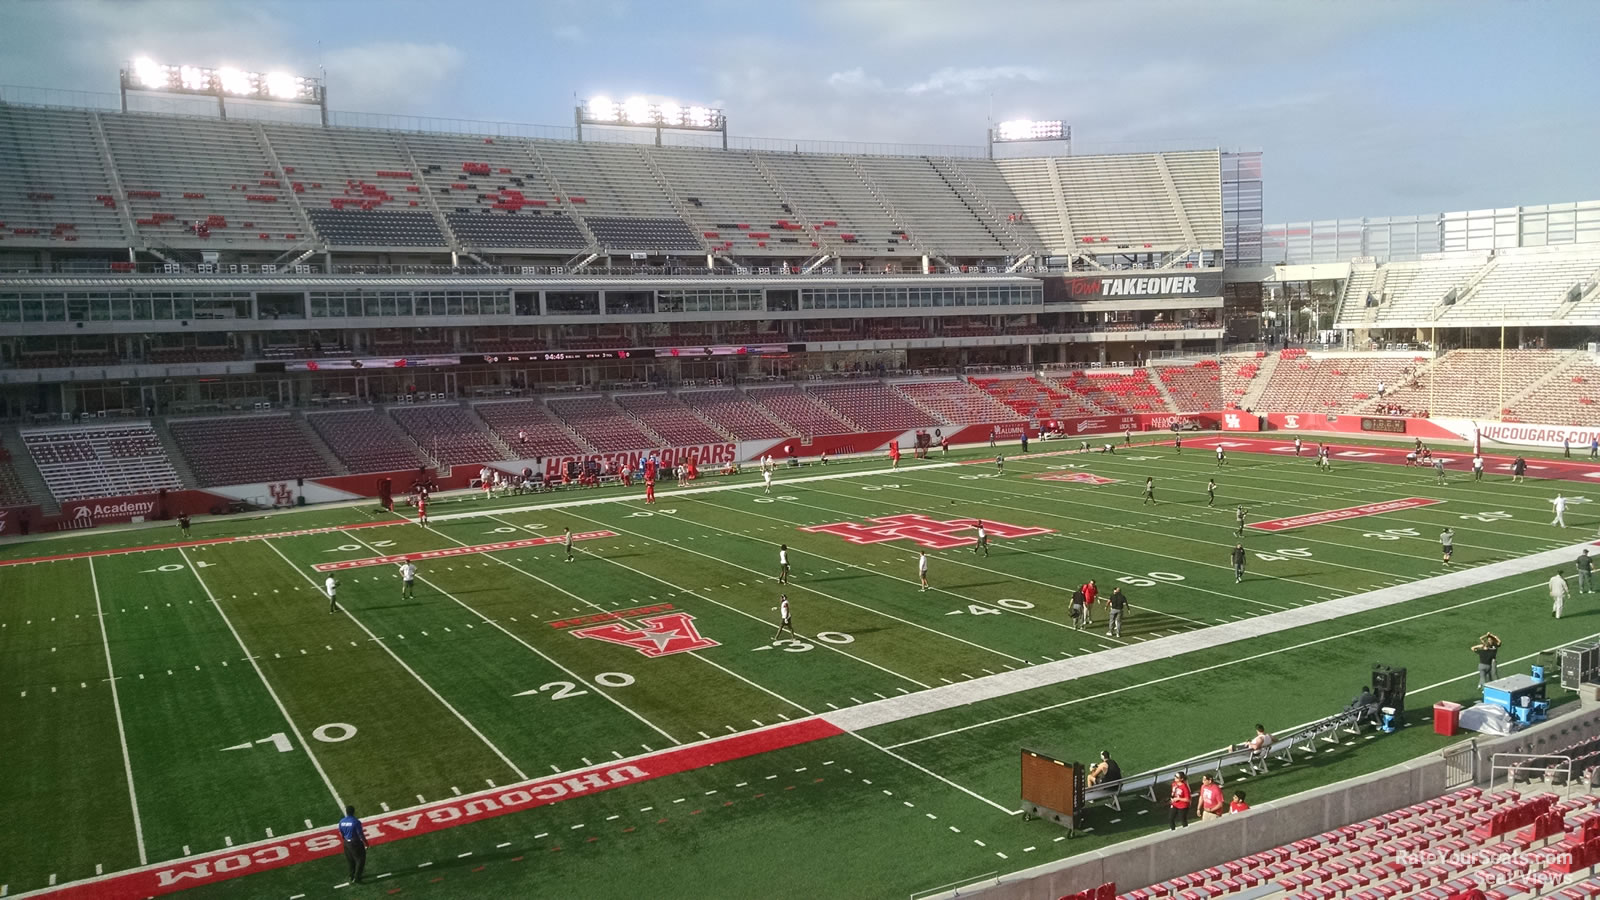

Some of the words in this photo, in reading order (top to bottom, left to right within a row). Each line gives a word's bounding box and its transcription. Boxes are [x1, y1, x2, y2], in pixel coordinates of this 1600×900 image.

[1101, 276, 1196, 296] TAKEOVER
[94, 502, 154, 515] Academy
[1116, 571, 1185, 587] 50
[967, 598, 1035, 616] 40
[772, 631, 855, 653] 30
[539, 672, 635, 700] 20
[256, 723, 357, 752] 10
